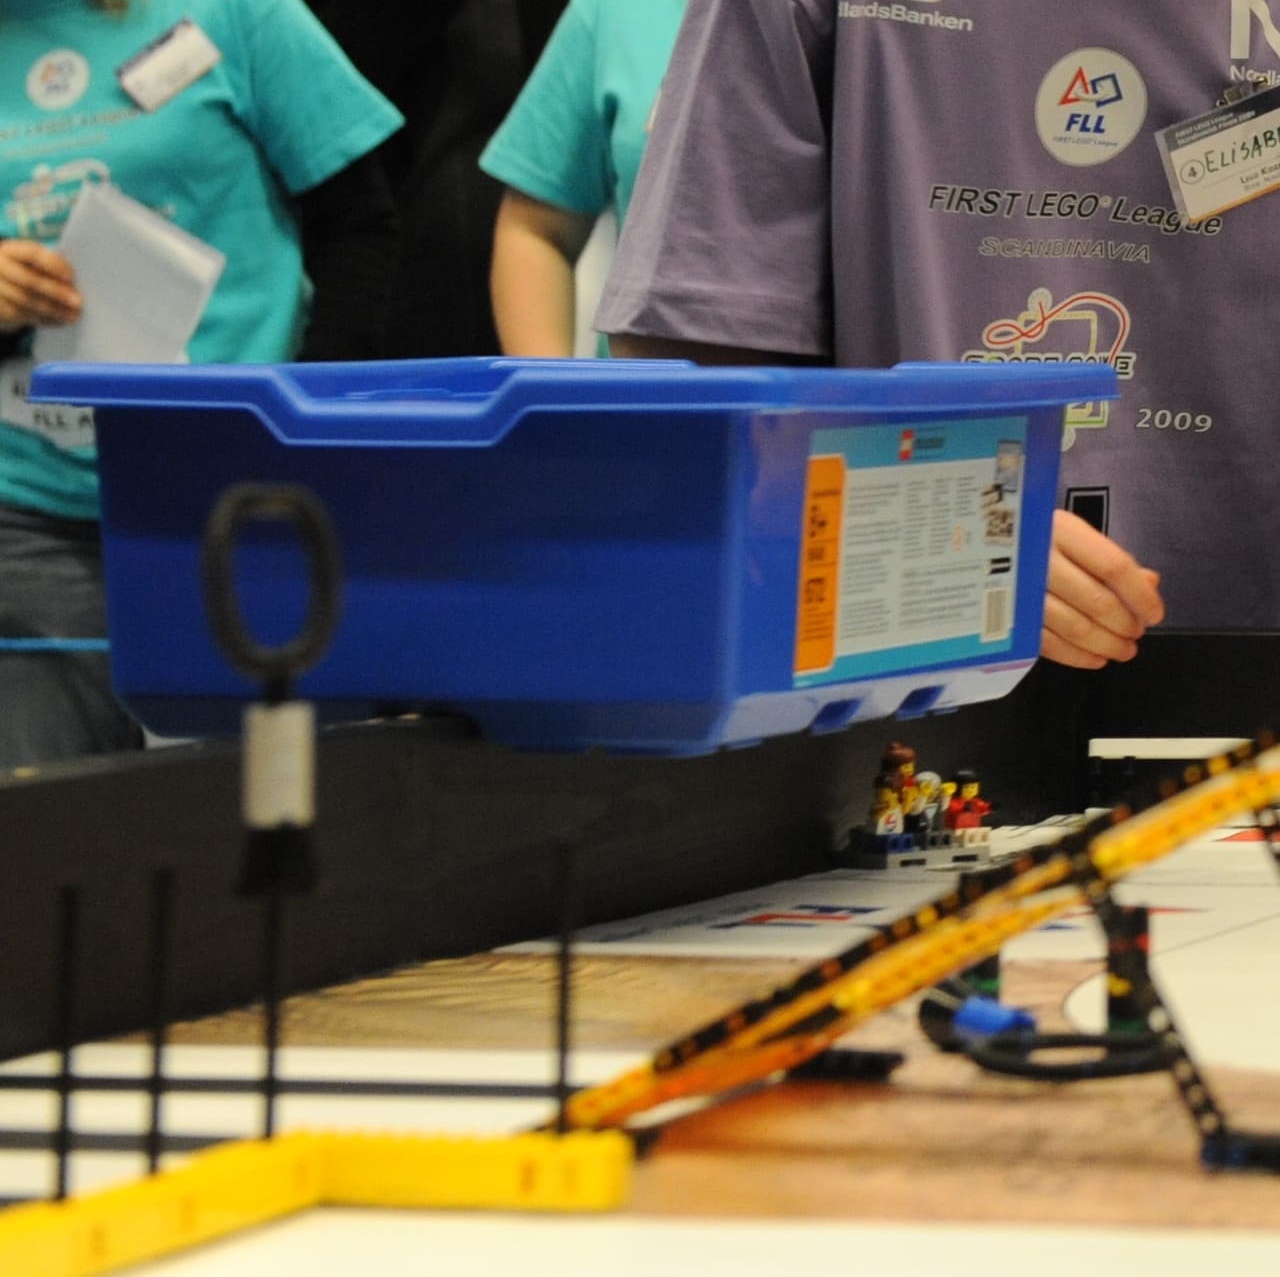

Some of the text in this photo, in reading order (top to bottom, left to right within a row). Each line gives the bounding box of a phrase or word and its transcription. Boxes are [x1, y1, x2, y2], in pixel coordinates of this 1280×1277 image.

[1065, 113, 1105, 134] FLL
[928, 185, 1022, 217] FIRST
[978, 236, 1151, 263] SCANDINAVIA
[1135, 407, 1214, 433] 2009
